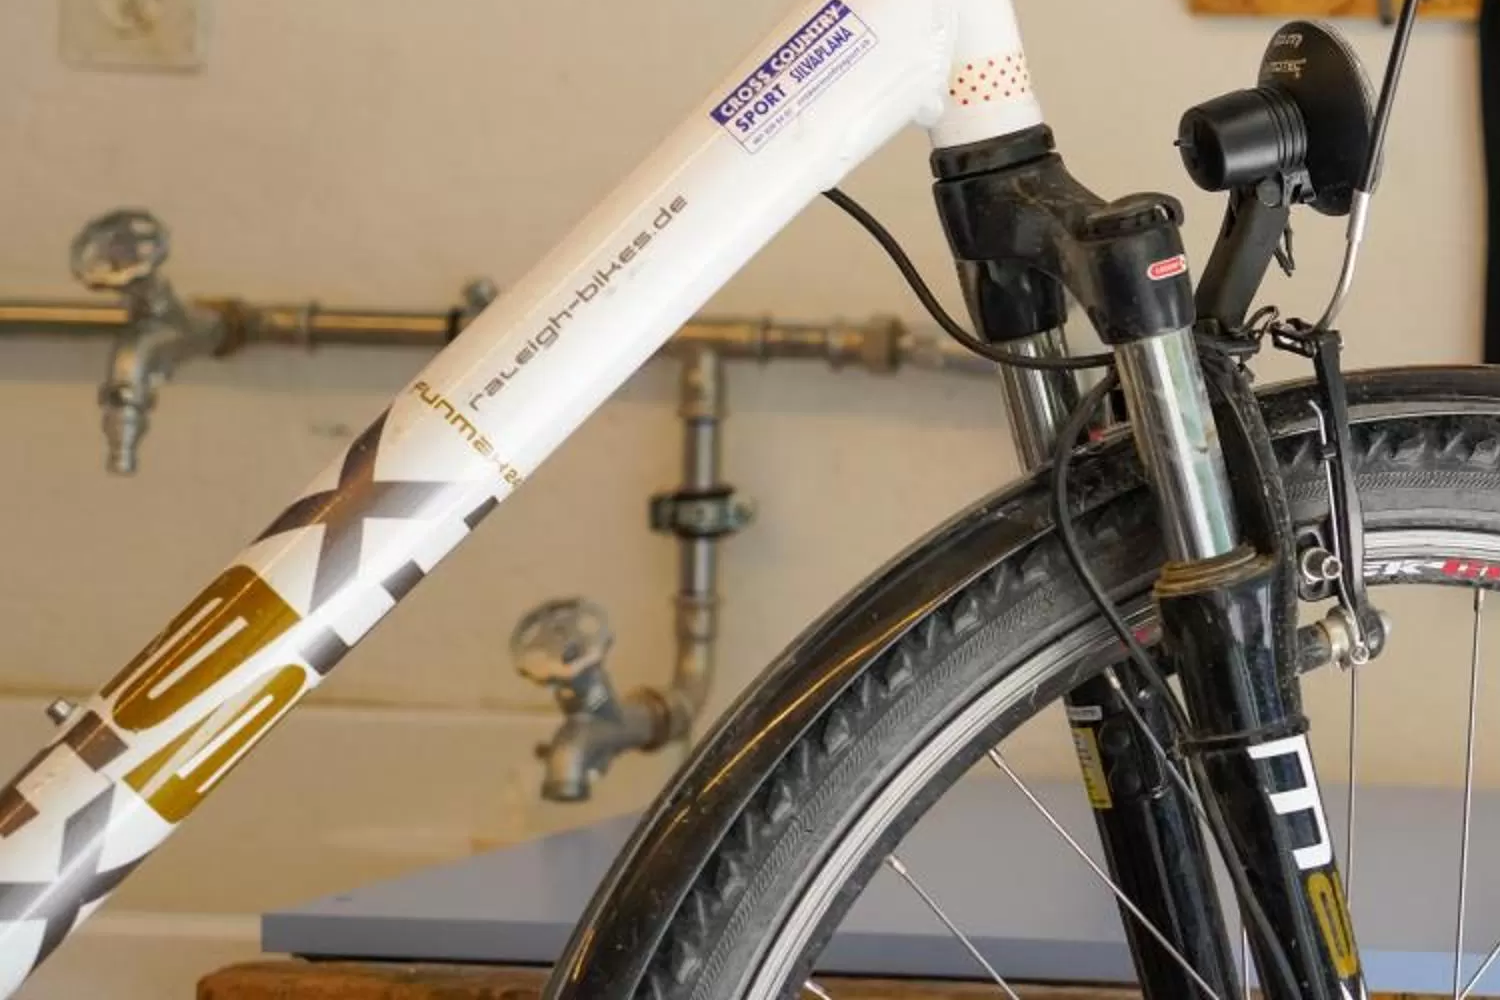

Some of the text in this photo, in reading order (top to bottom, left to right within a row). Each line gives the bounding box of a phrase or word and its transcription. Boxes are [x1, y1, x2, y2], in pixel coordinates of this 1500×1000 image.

[719, 68, 773, 117] CROSS
[769, 6, 841, 69] COUNTRY
[735, 83, 787, 133] SPORT
[789, 25, 855, 83] SILVAPLANA
[469, 195, 688, 412] raleigh-bikes.de
